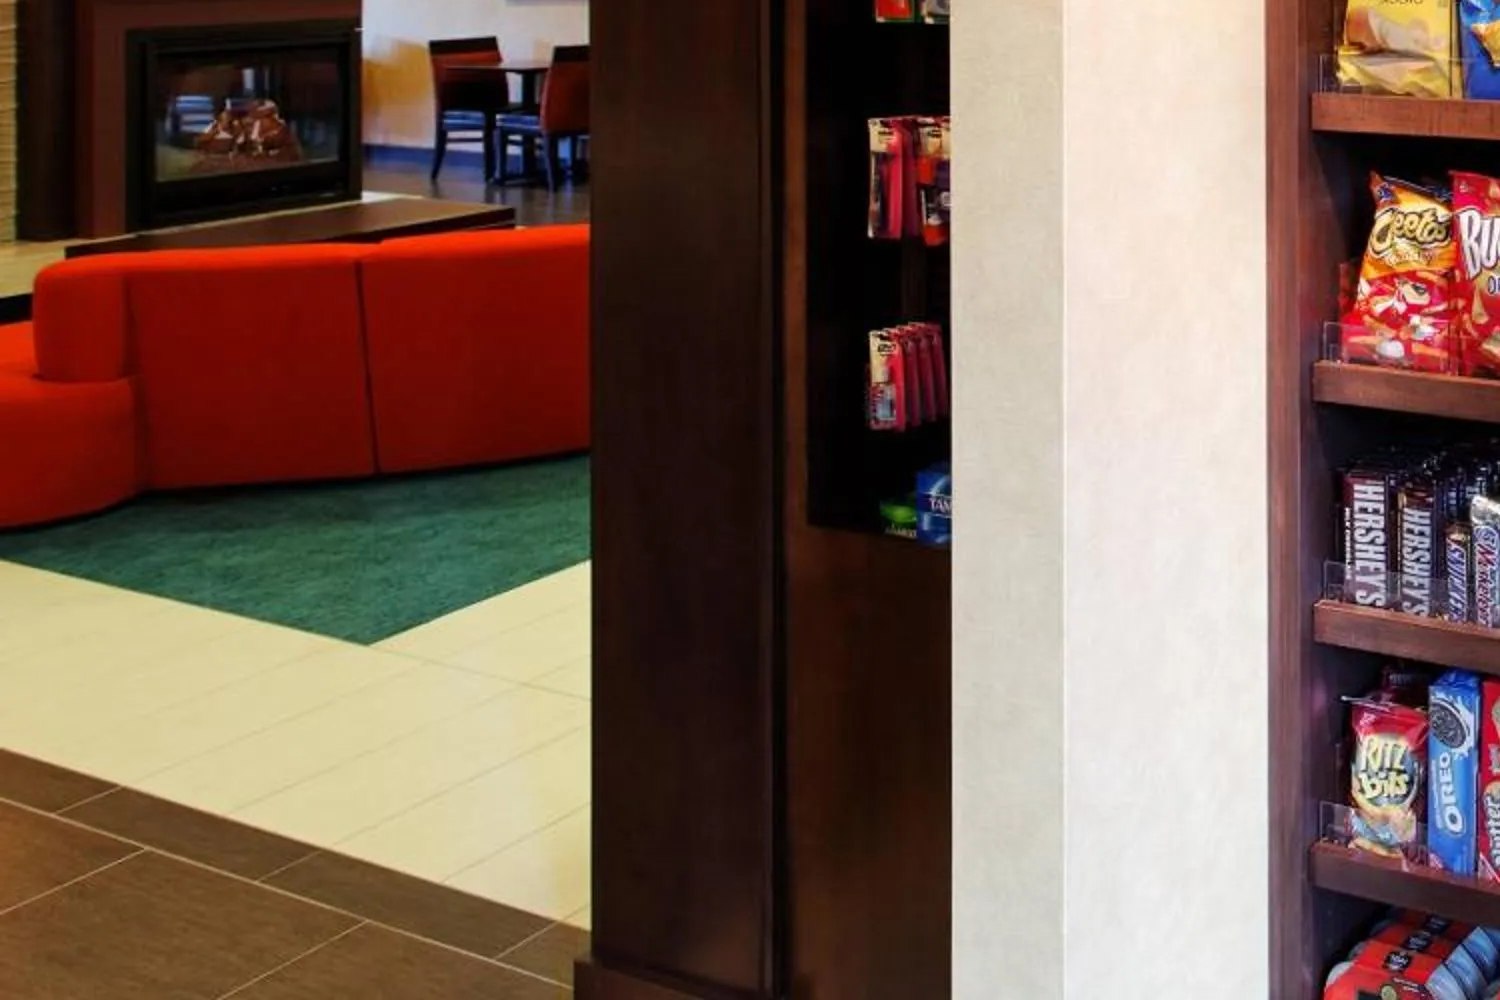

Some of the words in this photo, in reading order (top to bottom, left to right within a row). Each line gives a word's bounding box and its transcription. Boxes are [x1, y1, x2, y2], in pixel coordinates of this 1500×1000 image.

[1353, 482, 1386, 607] HERSHEY'S
[1401, 508, 1431, 617] HERSHEY'S
[1438, 751, 1464, 833] OREO
